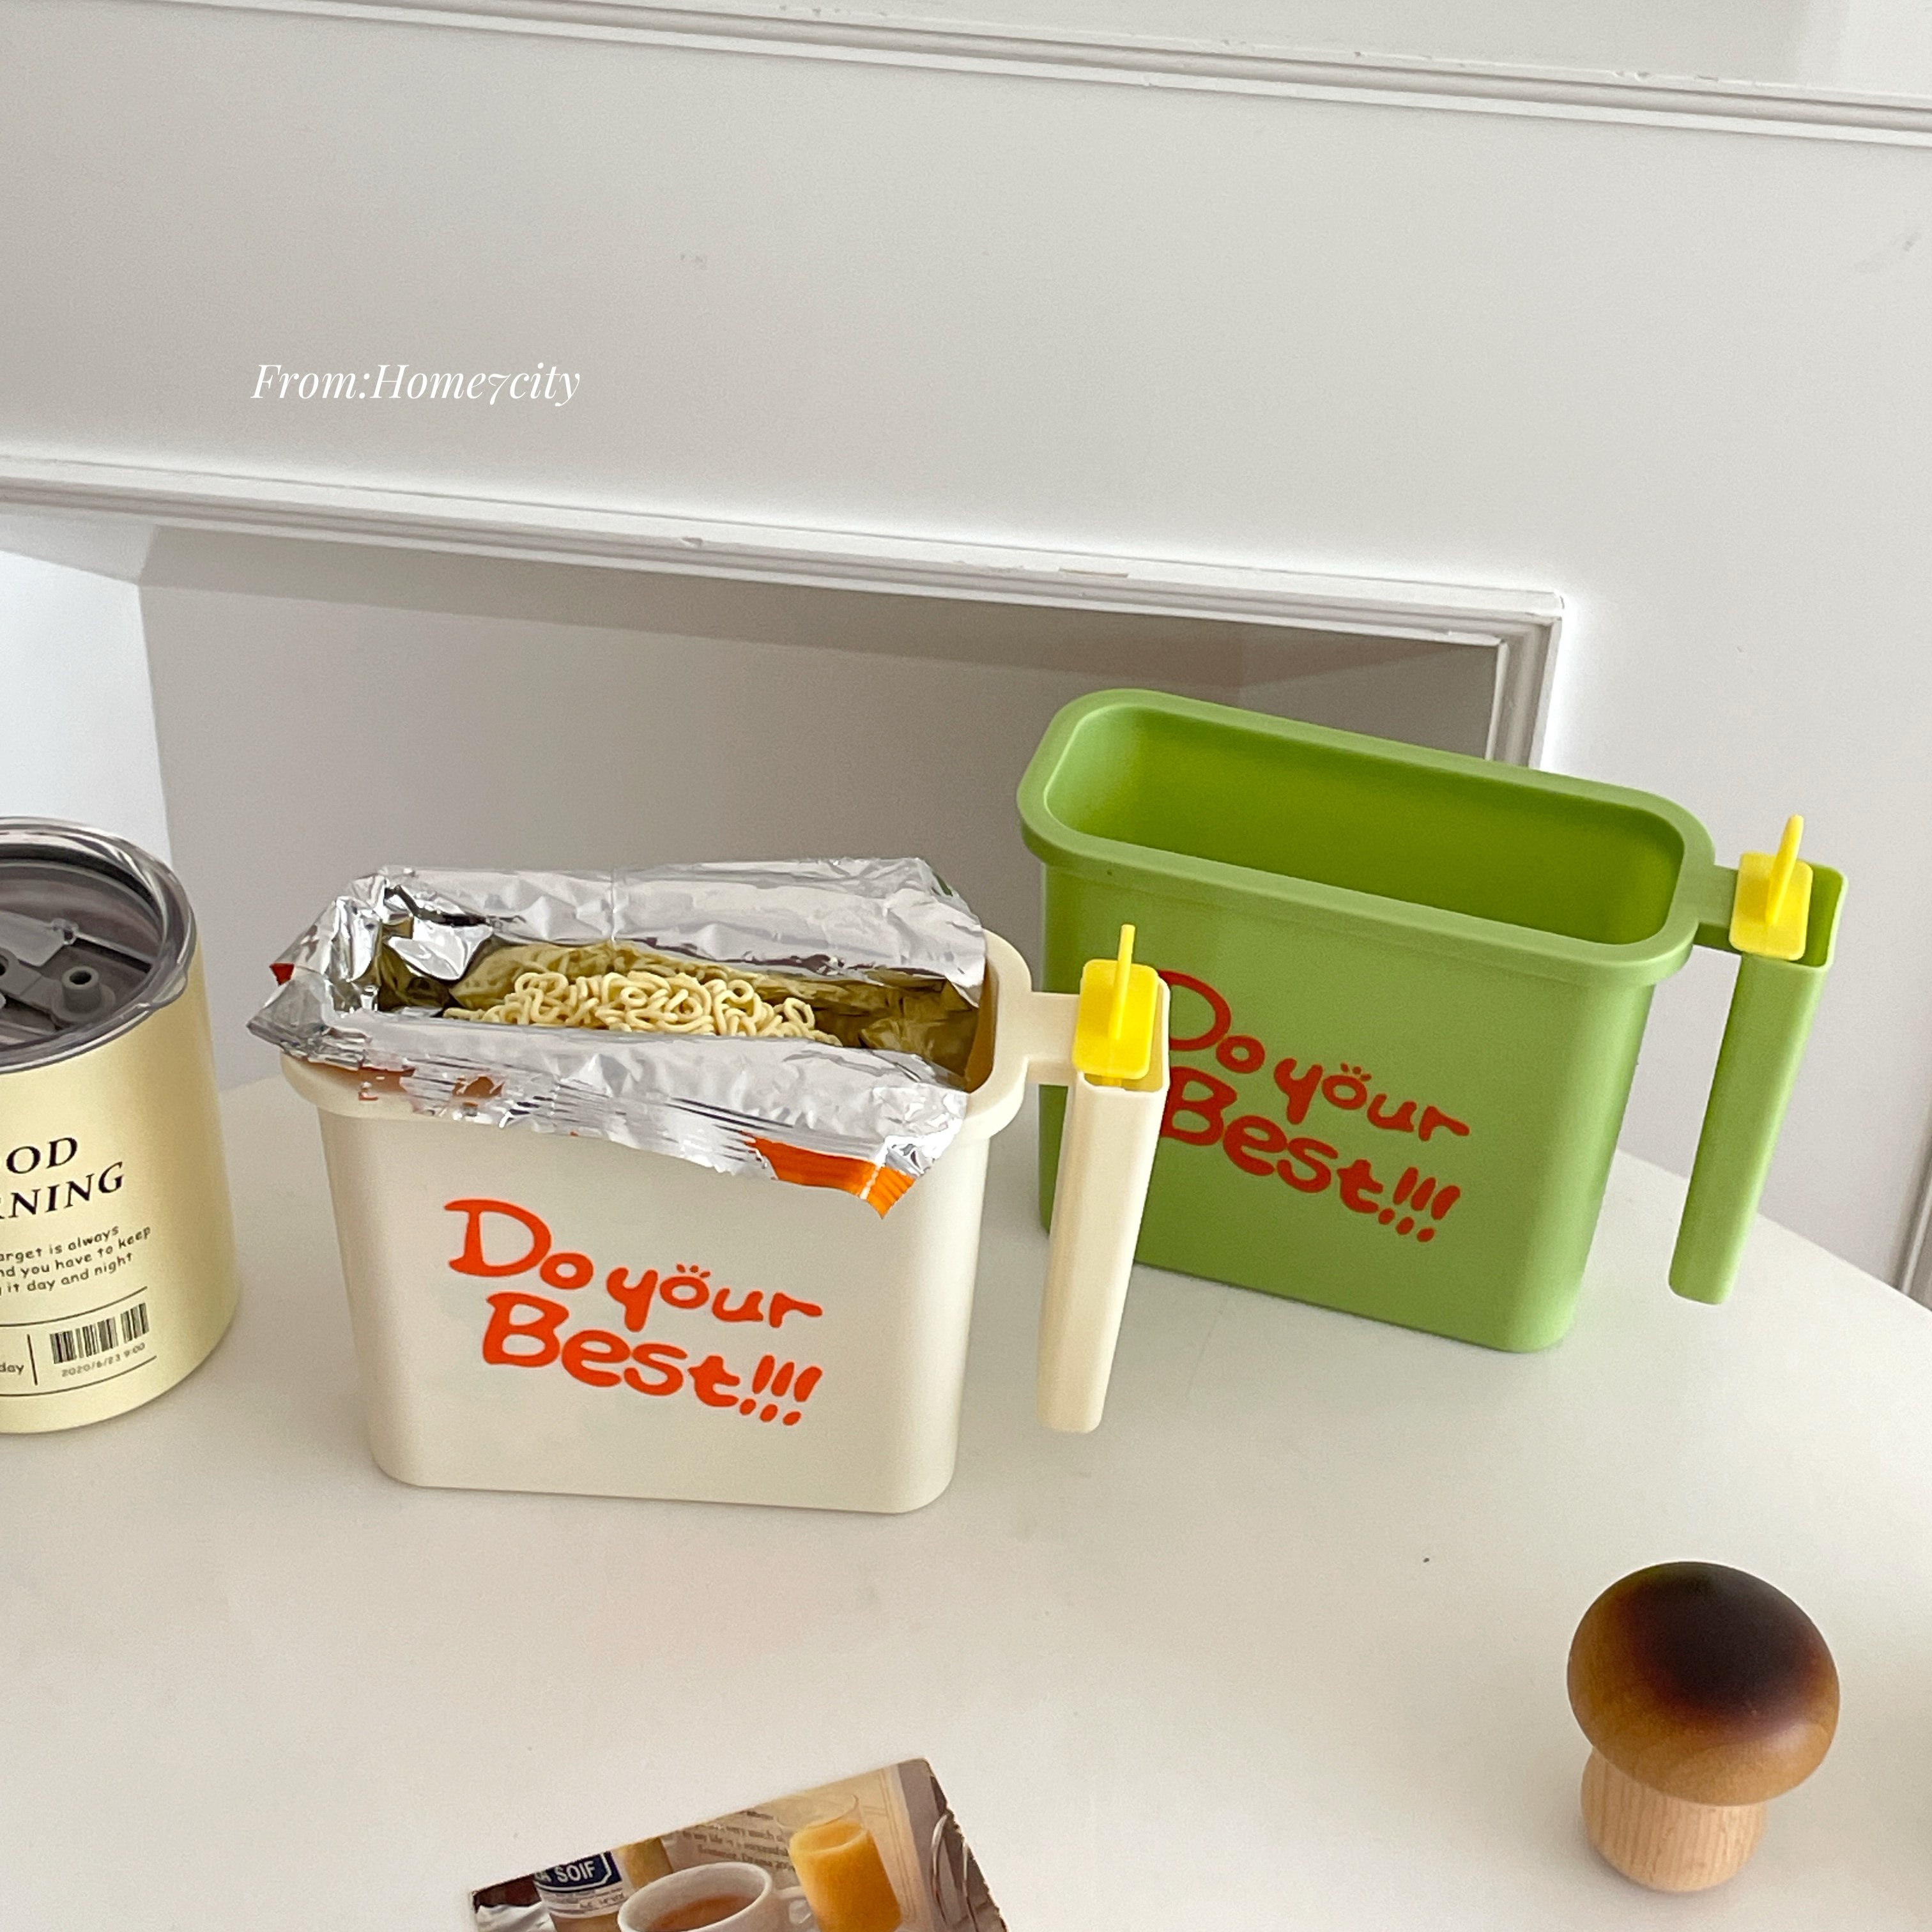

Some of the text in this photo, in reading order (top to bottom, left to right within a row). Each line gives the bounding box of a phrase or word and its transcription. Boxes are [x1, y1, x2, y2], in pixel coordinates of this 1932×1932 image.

[1157, 969, 1470, 1142] Do your
[6, 1137, 78, 1174] OD
[1160, 1066, 1460, 1243] Best!!!
[0, 1162, 124, 1220] NING
[20, 1262, 50, 1278] you
[55, 1252, 93, 1270] have
[97, 1245, 114, 1258] to
[118, 1226, 151, 1250] keep
[49, 1244, 63, 1254] is
[68, 1225, 119, 1252] always
[443, 1199, 824, 1333] Do your
[8, 1282, 20, 1293] it
[27, 1280, 56, 1292] day
[61, 1268, 89, 1286] and
[95, 1252, 132, 1276] night
[482, 1291, 823, 1427] Best!!!
[554, 1860, 596, 1883] SOIF
